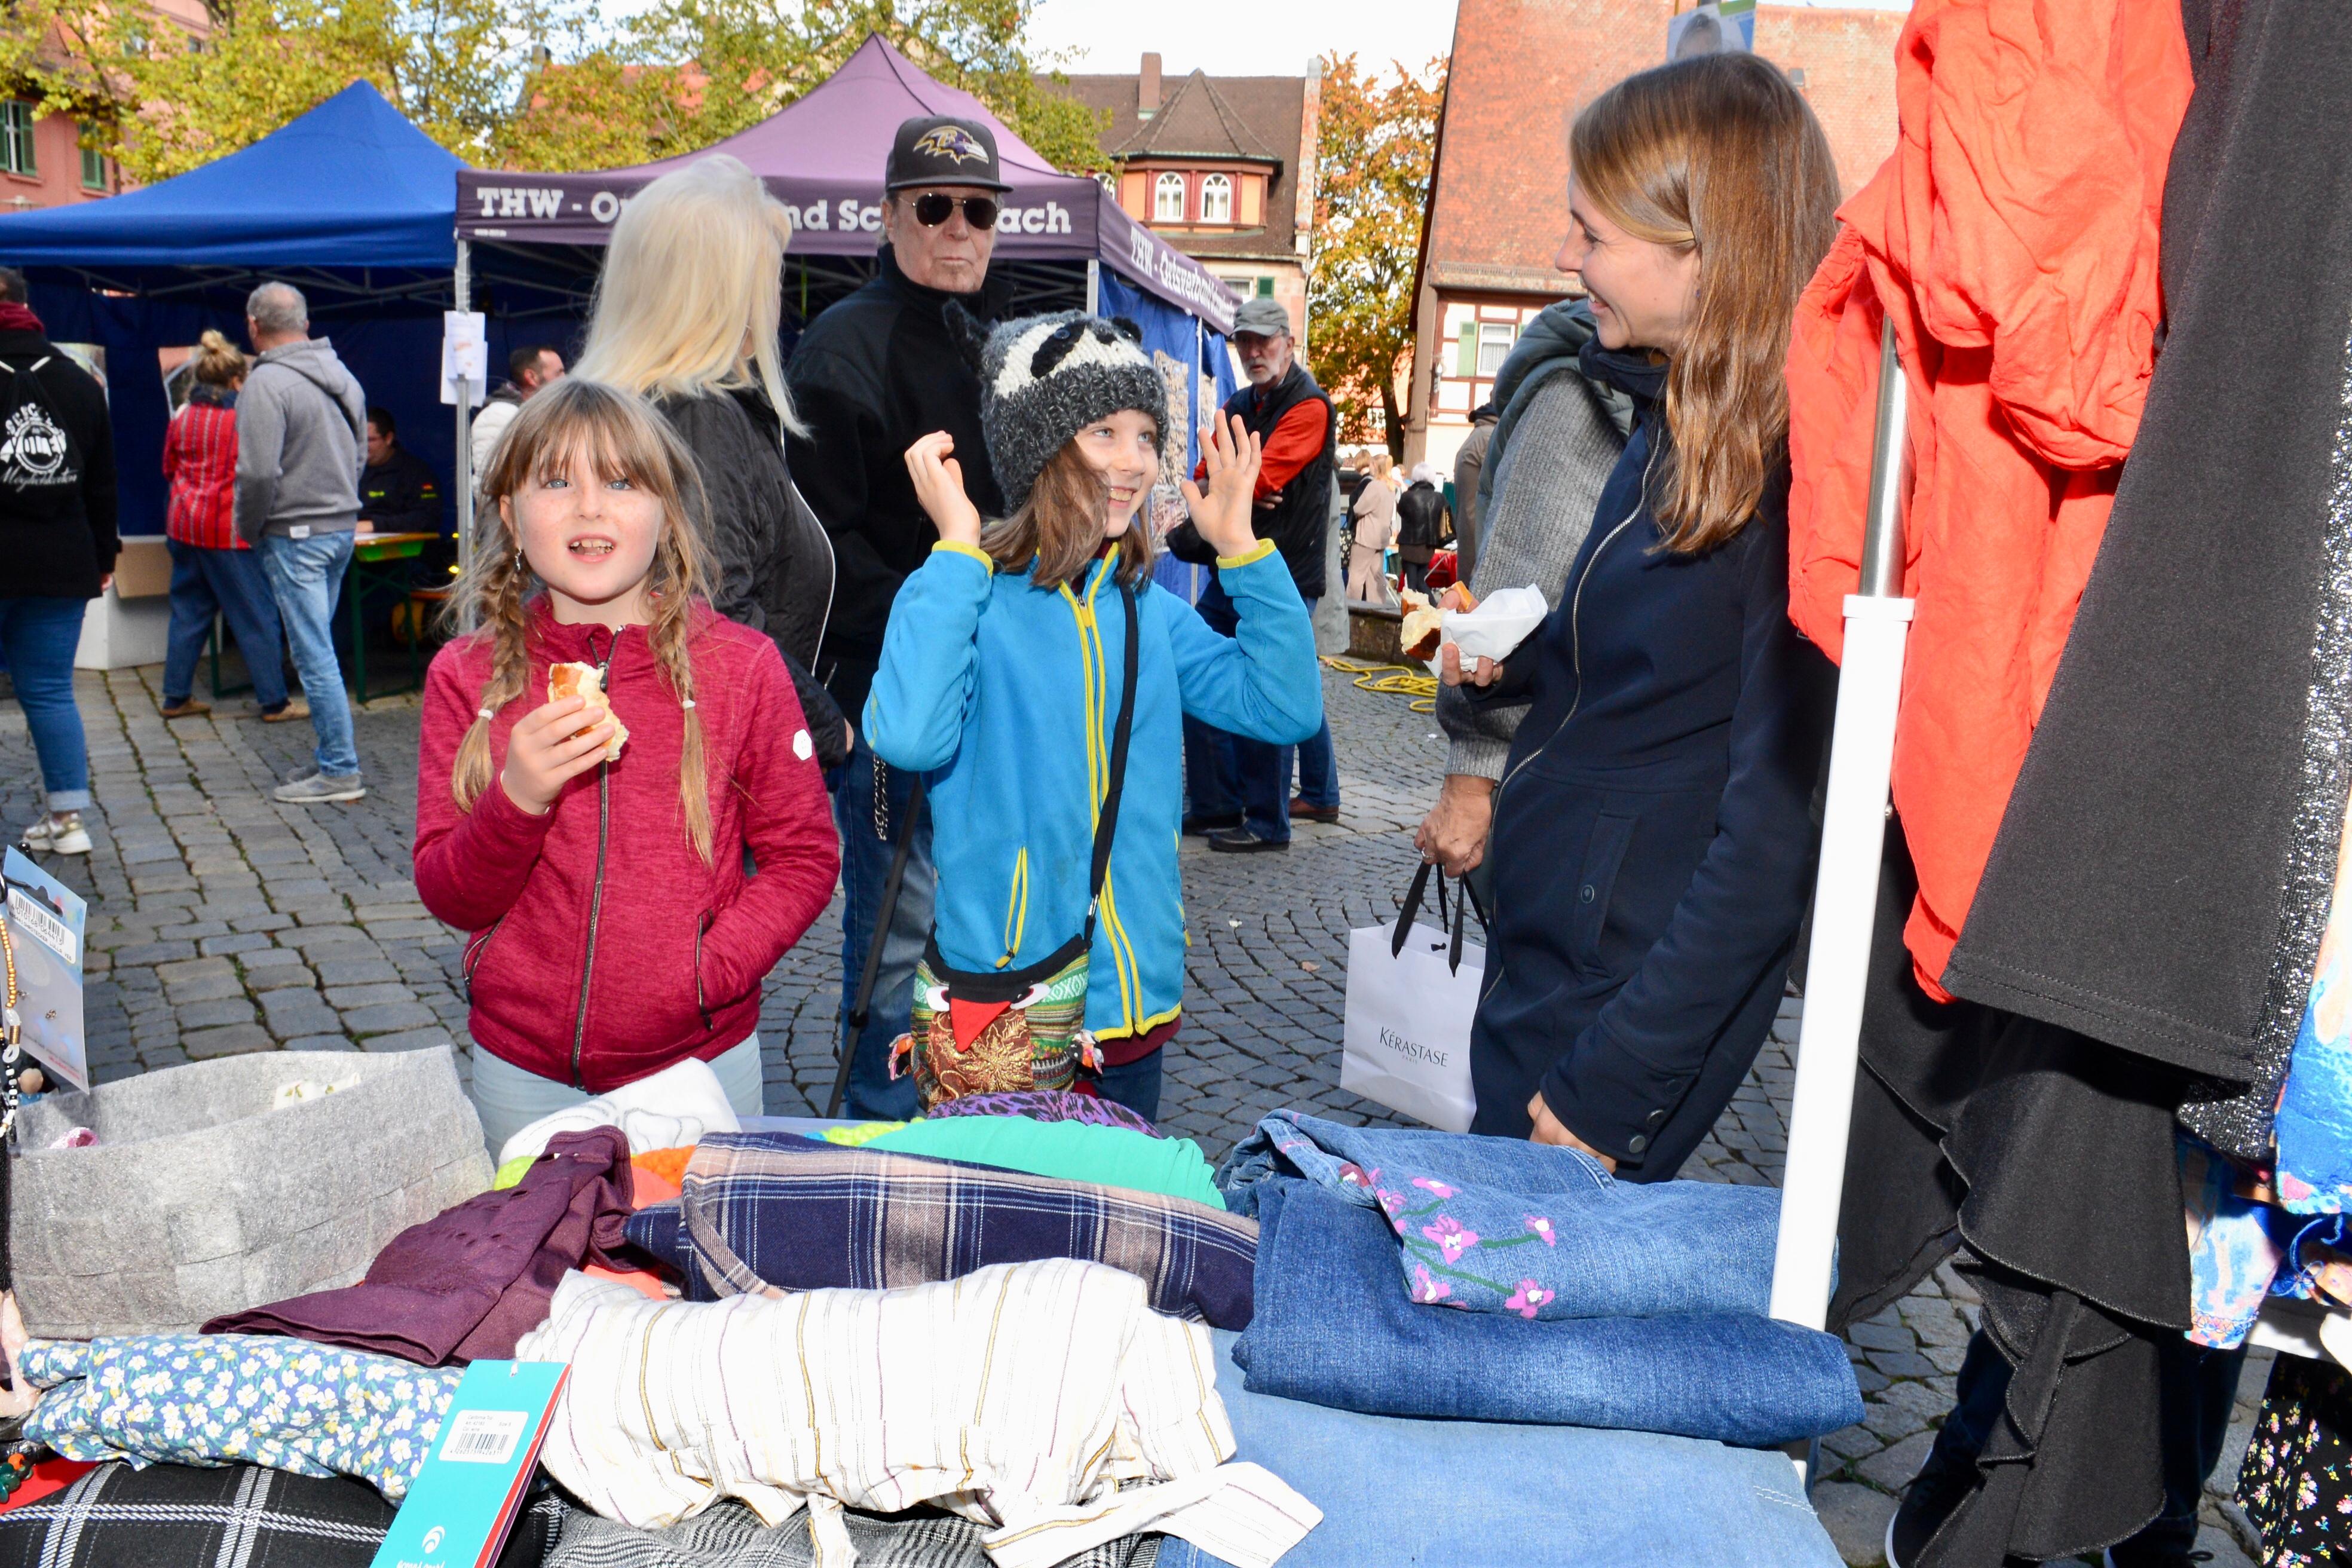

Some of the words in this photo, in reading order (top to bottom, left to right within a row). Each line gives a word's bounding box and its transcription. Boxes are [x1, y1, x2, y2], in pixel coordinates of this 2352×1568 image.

[476, 187, 564, 219] THW
[1131, 225, 1154, 278] THW
[1380, 1027, 1448, 1067] KÉRASTASE
